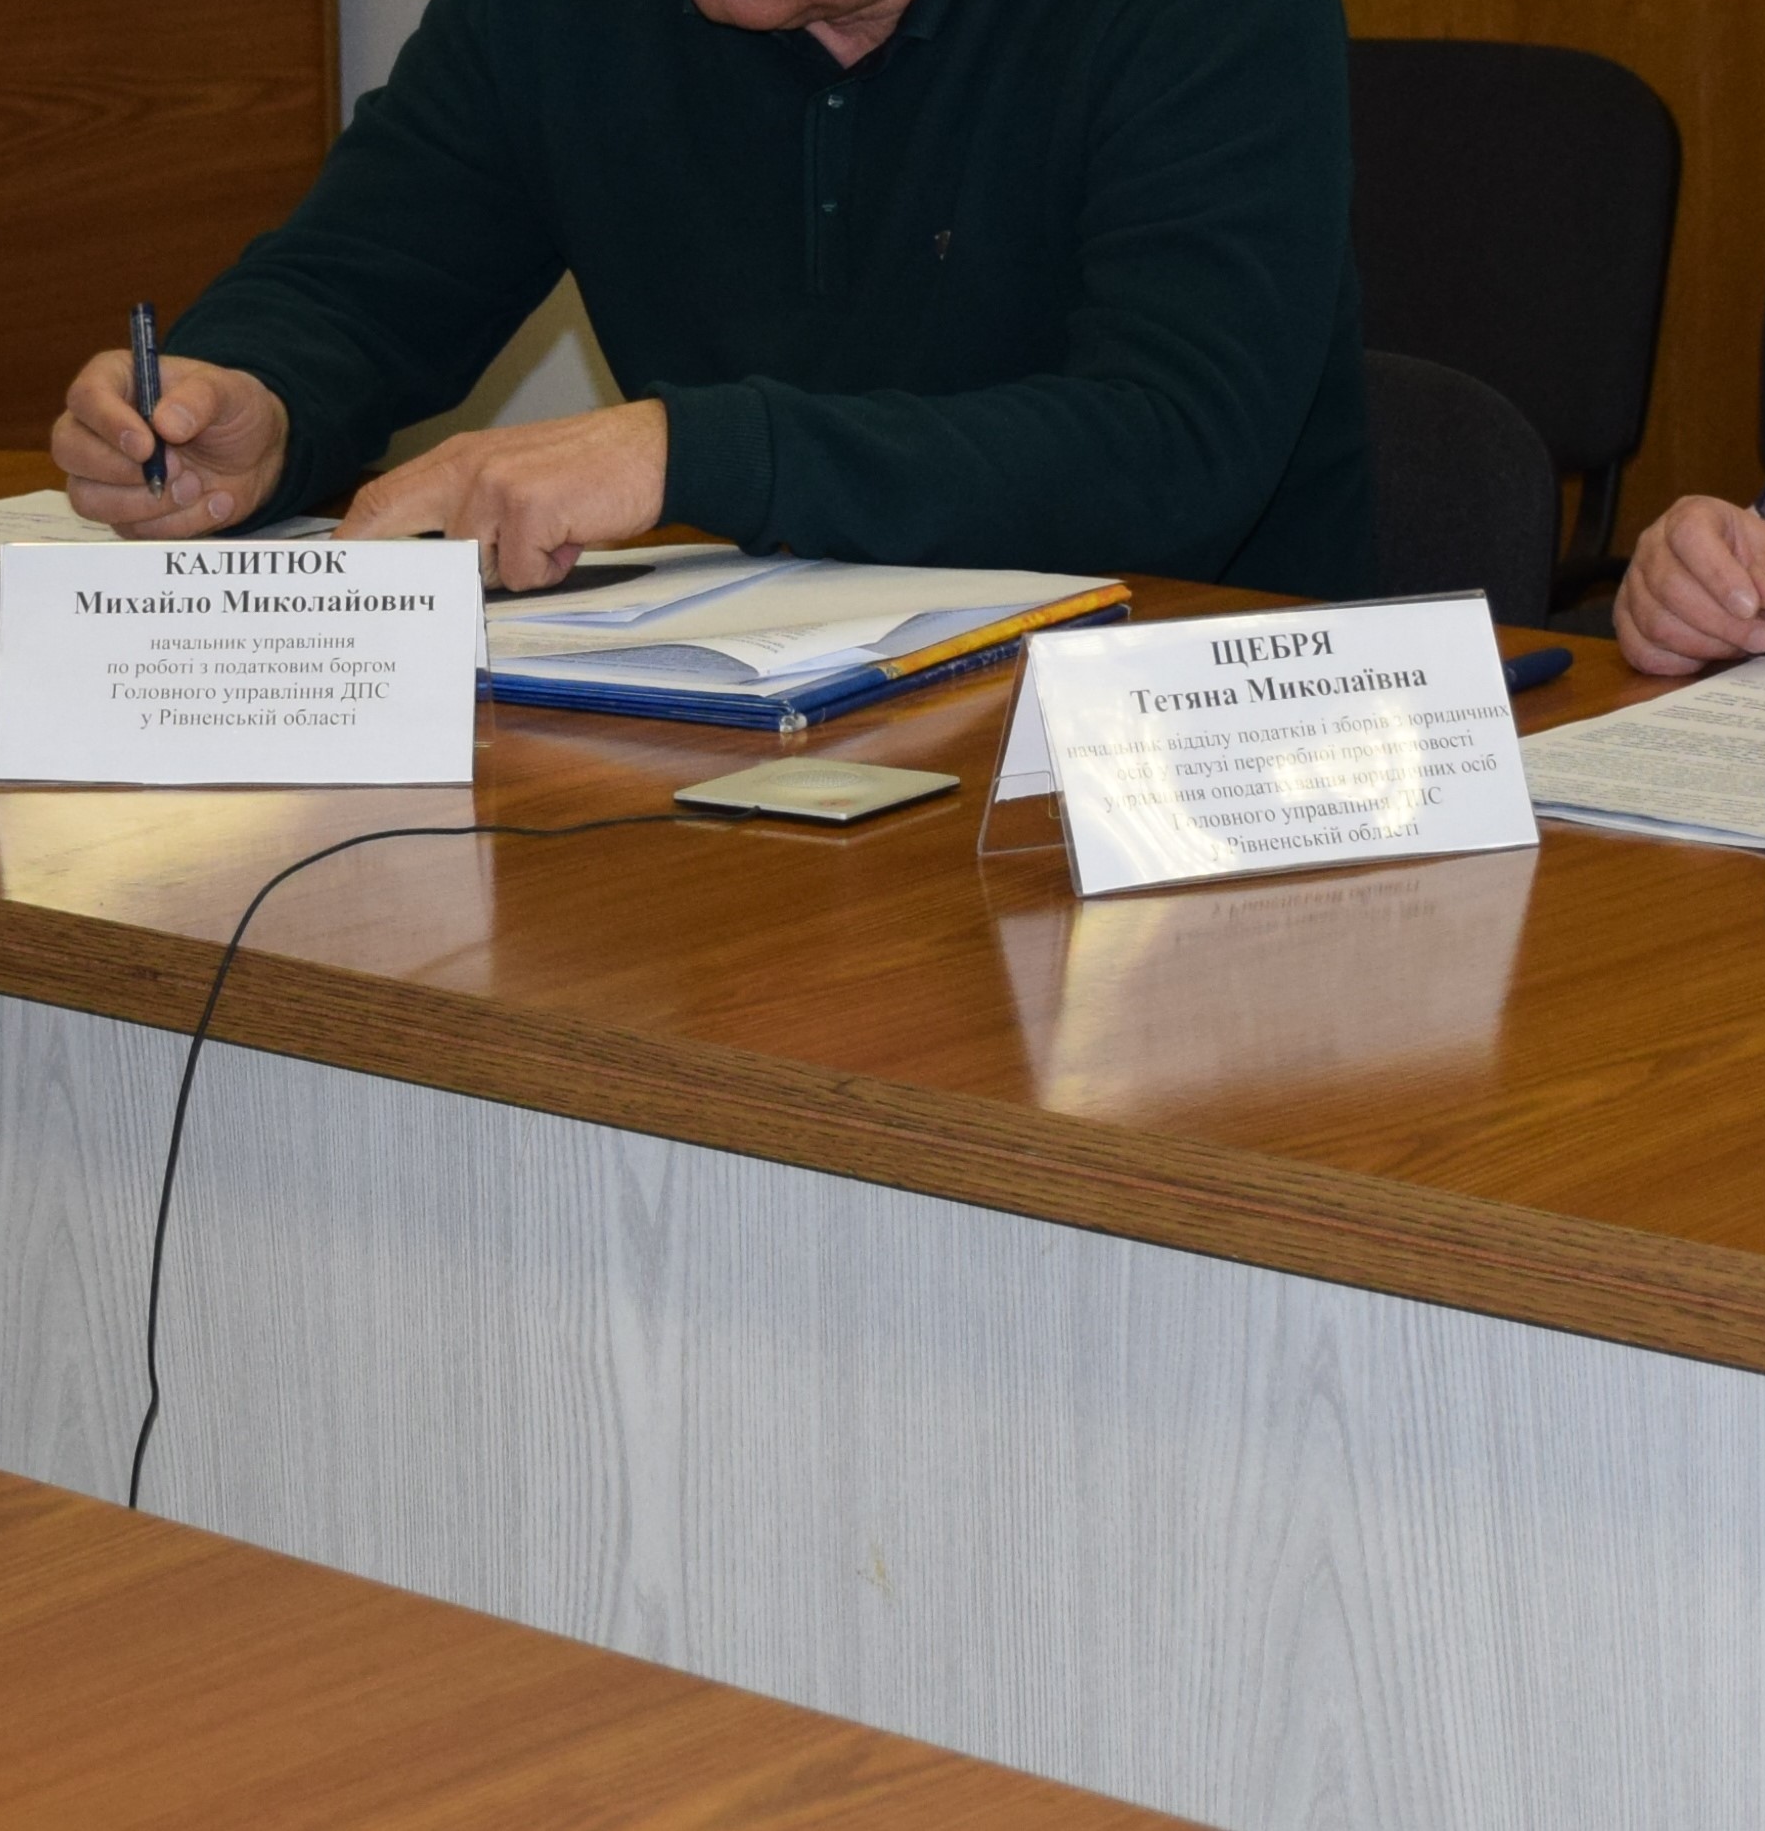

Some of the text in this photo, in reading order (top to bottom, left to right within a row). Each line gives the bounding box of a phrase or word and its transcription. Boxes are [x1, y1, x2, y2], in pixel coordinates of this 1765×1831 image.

[164, 550, 347, 576] КАЛИТЮК
[75, 589, 436, 614] Михайло Миколайович
[150, 634, 356, 652] начальник управління
[1210, 631, 1333, 668] ЩЕБРЯ
[107, 657, 396, 678] по роботі з податковим боргом
[110, 682, 389, 703] Головного управління ДПС
[1130, 667, 1427, 715] Тетяна Миколаївна
[140, 708, 356, 729] у Рівненській області
[1168, 730, 1230, 751] відділу
[1238, 714, 1316, 745] податків
[1322, 717, 1327, 734] і
[1334, 712, 1389, 736] зборів
[1409, 703, 1510, 730] юридичних
[1117, 762, 1153, 781] осіб
[1176, 754, 1228, 777] галузі
[1234, 744, 1335, 772] переробної
[1461, 754, 1497, 773] осіб
[1282, 794, 1390, 825] управління
[1227, 824, 1342, 854] Рівненській
